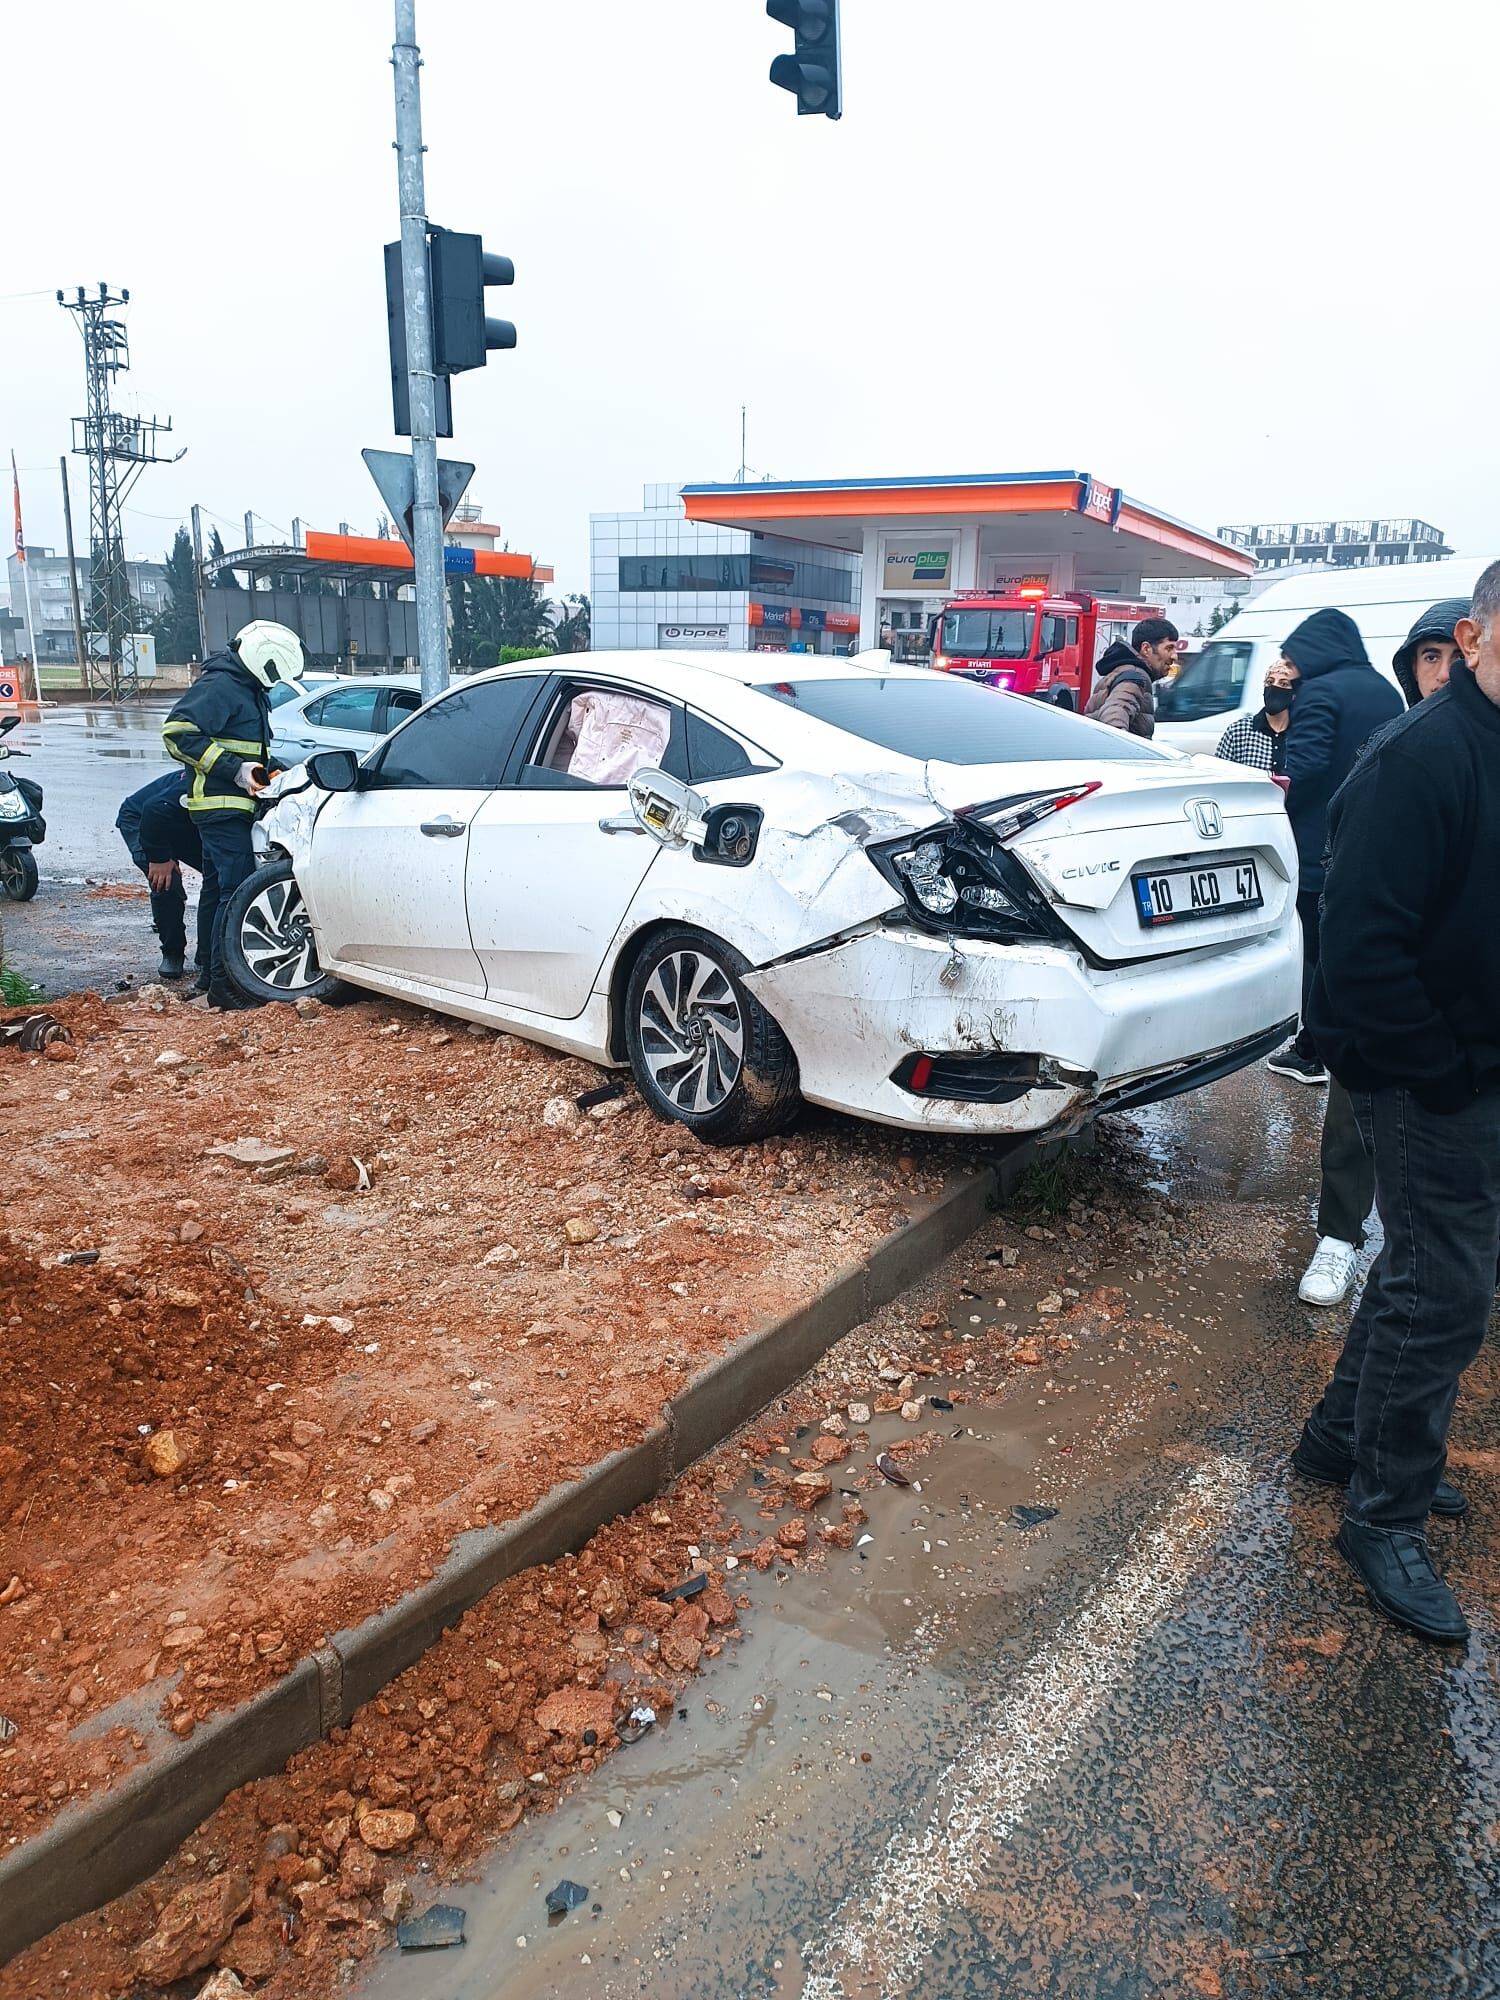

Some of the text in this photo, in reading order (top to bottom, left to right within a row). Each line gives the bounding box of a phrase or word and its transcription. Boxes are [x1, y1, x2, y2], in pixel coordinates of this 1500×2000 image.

[1093, 484, 1113, 513] bpet
[887, 553, 946, 566] europlus
[996, 575, 1047, 585] europlus
[764, 611, 785, 621] Market
[682, 628, 727, 638] bpet
[1062, 860, 1120, 879] CIVIC
[1150, 867, 1252, 913] 10 ACD 47
[1142, 901, 1152, 912] TR
